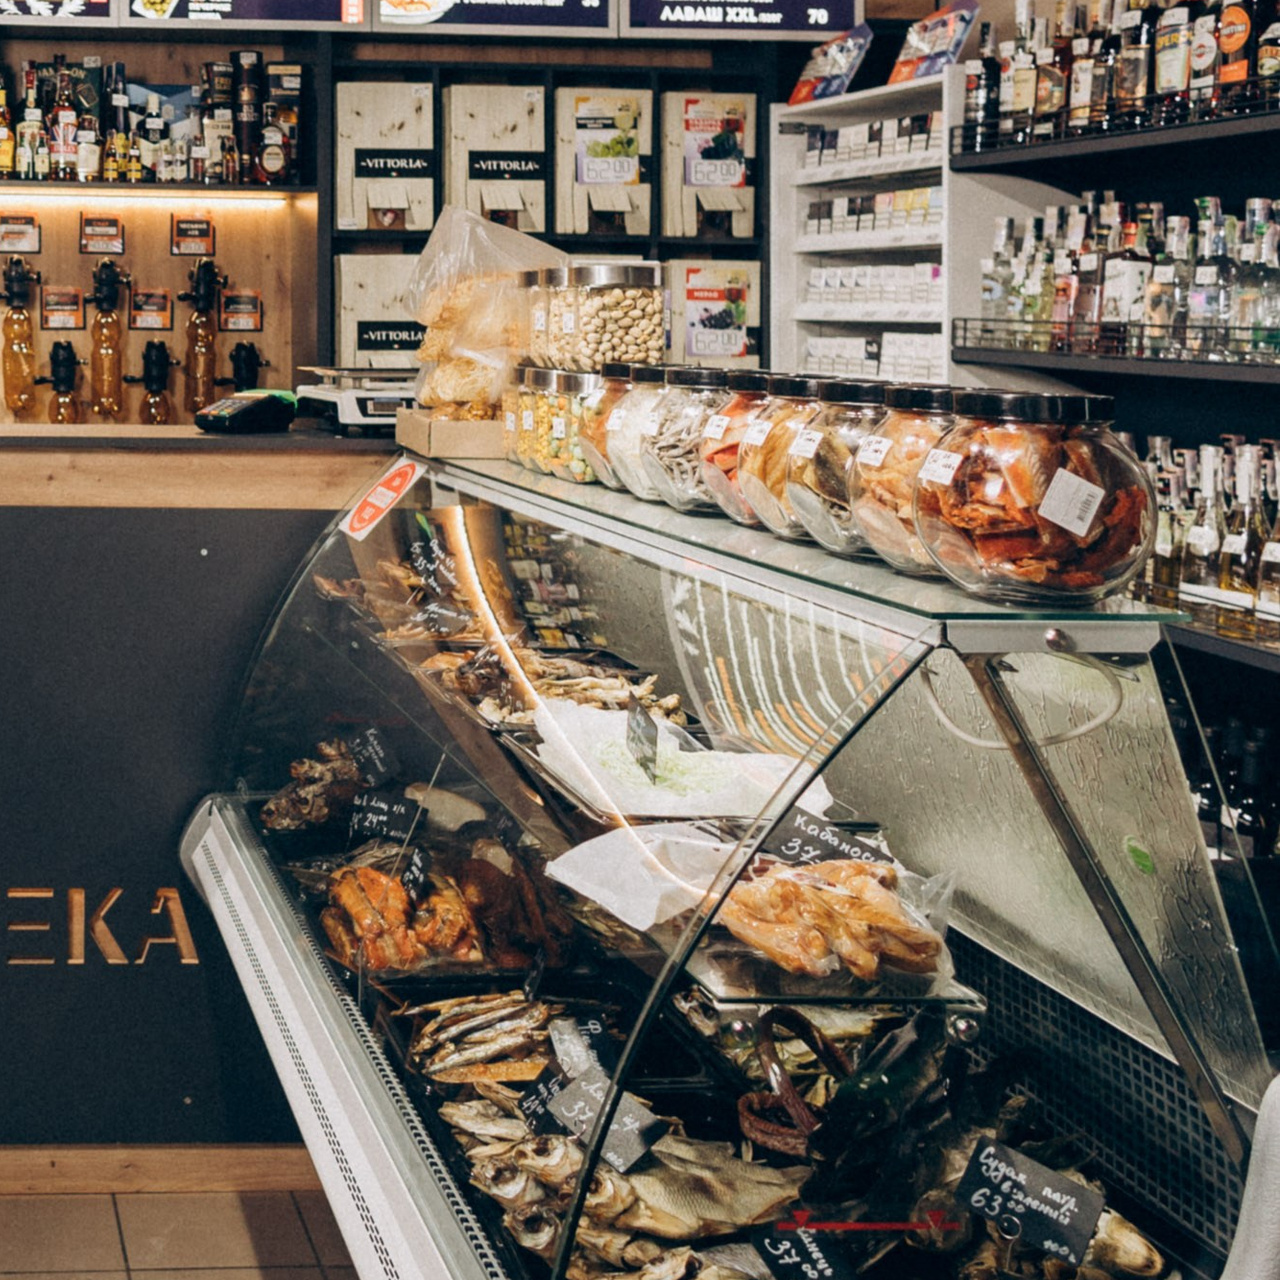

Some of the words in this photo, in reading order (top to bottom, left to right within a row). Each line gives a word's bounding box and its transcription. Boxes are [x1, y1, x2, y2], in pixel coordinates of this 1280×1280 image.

[660, 5, 723, 22] ЛАВАШ
[726, 7, 757, 23] XXL
[807, 9, 828, 24] 70
[368, 157, 423, 169] VITTORIA
[481, 159, 535, 171] VITTORIA
[979, 1146, 1027, 1185] Судак
[970, 1187, 1002, 1216] 63
[763, 1238, 801, 1264] 37
